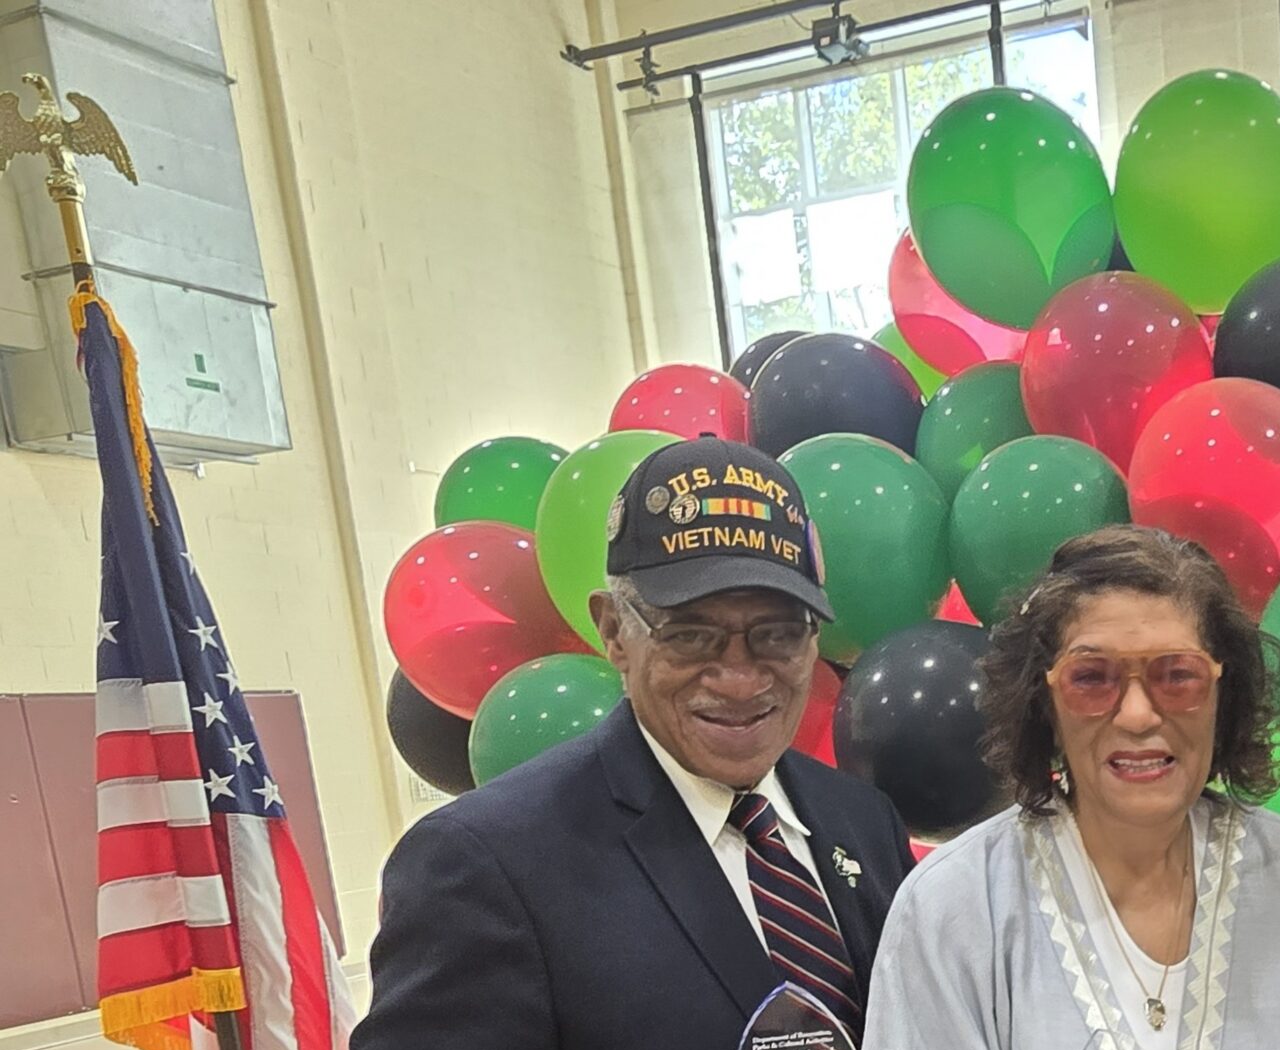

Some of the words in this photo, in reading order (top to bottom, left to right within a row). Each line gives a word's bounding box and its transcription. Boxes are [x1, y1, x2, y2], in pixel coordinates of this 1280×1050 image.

[668, 467, 718, 496] U.S.
[723, 464, 789, 507] ARMY
[662, 526, 765, 555] VIETNAM
[770, 534, 802, 565] VET
[752, 1043, 770, 1050] Parks
